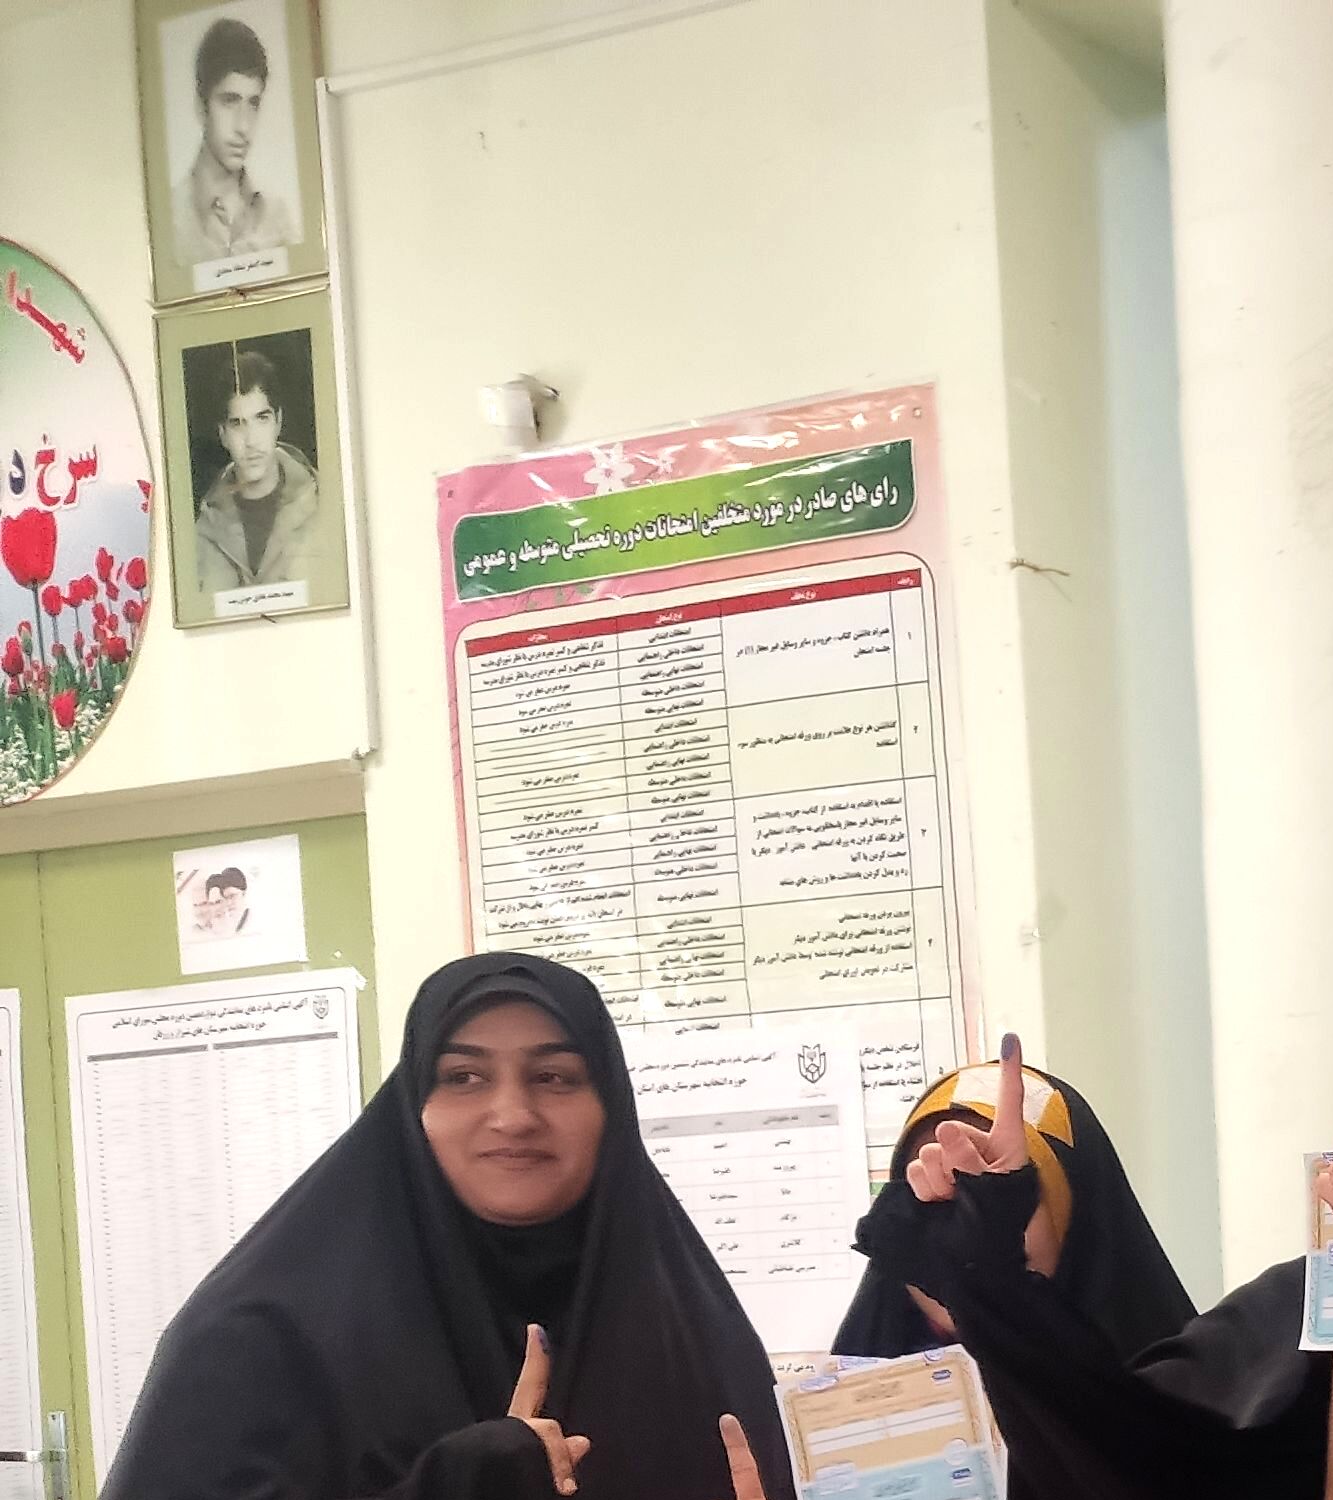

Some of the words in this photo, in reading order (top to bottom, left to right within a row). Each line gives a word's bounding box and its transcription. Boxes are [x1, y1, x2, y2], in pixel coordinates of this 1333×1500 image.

[805, 486, 838, 520] صادر
[840, 479, 867, 513] های
[870, 475, 898, 508] رای
[644, 508, 699, 540] امتحانات
[700, 503, 750, 536] متخلفین
[754, 501, 784, 527] مورد
[786, 495, 802, 523] در
[518, 537, 560, 564] متوسطه
[562, 525, 611, 561] تحصیلی
[613, 523, 643, 551] دوره
[463, 549, 506, 576] عمومی
[508, 550, 517, 571] و
